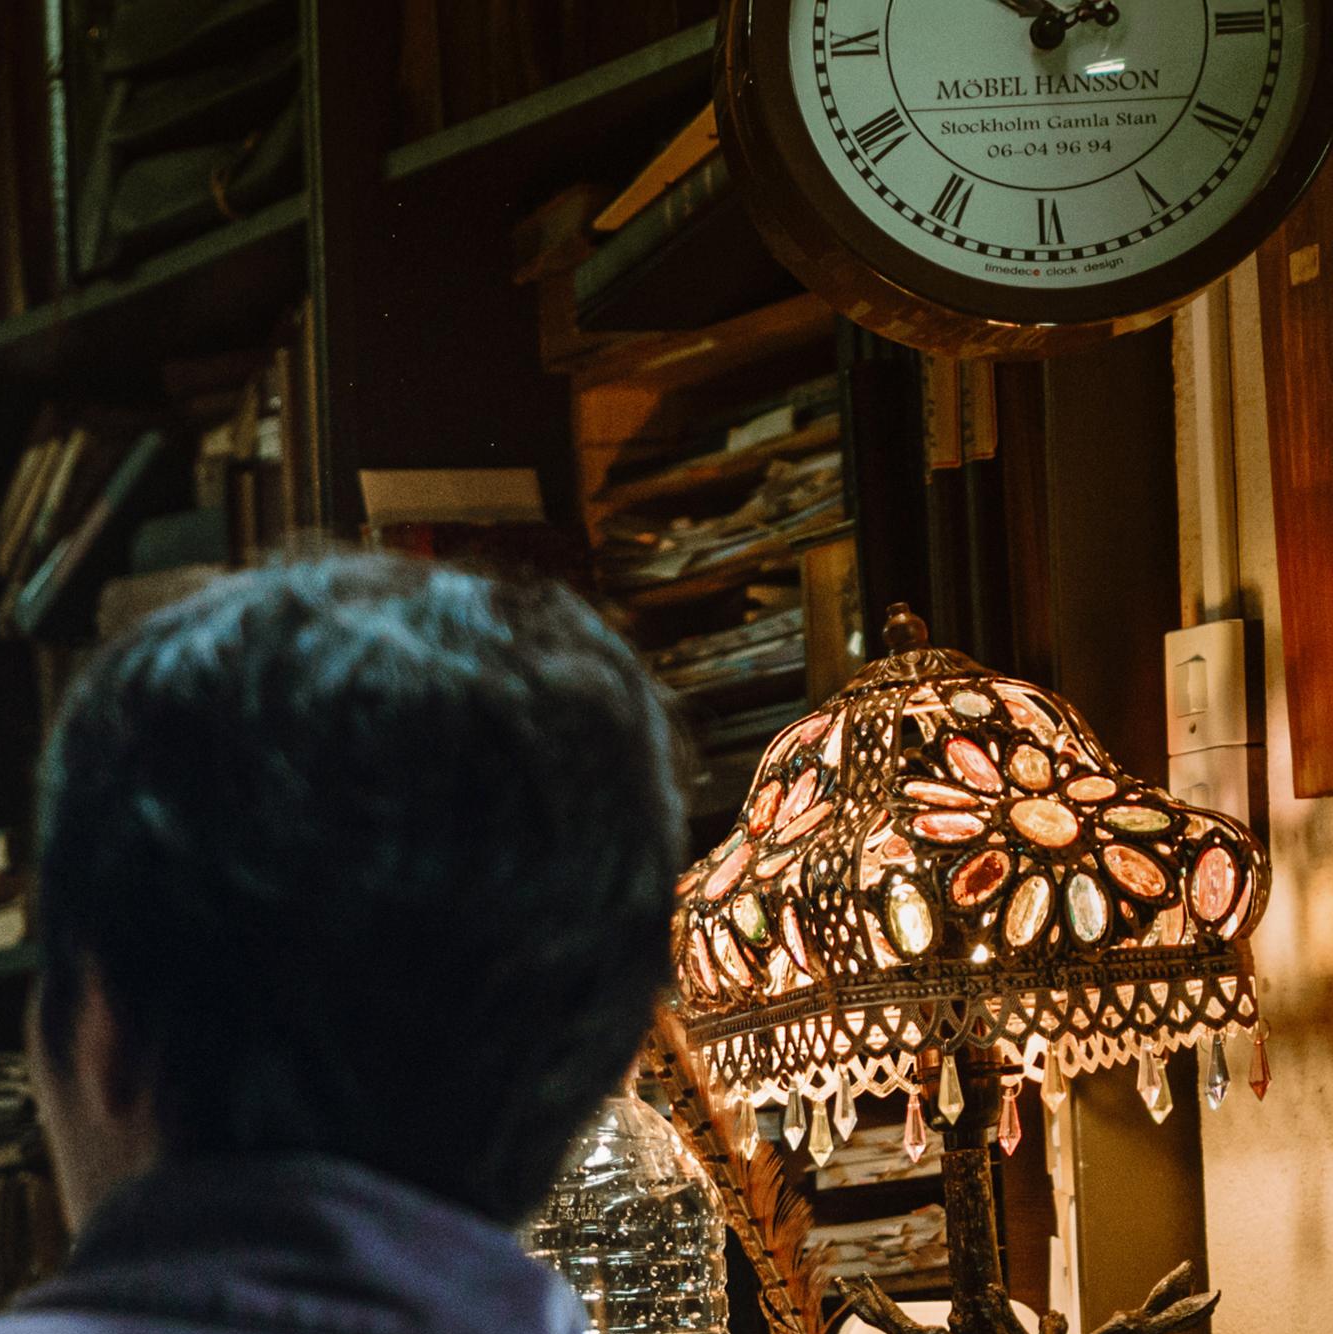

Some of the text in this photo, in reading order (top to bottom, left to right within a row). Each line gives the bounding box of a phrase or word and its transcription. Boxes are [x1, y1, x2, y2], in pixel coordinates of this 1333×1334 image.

[937, 69, 1160, 100] MÖBEL HANSSON
[941, 111, 1157, 135] Stockholm Gamla Stan
[1056, 140, 1082, 154] 96
[1088, 139, 1112, 153] 94
[1046, 264, 1077, 277] clock
[1084, 256, 1125, 272] design
